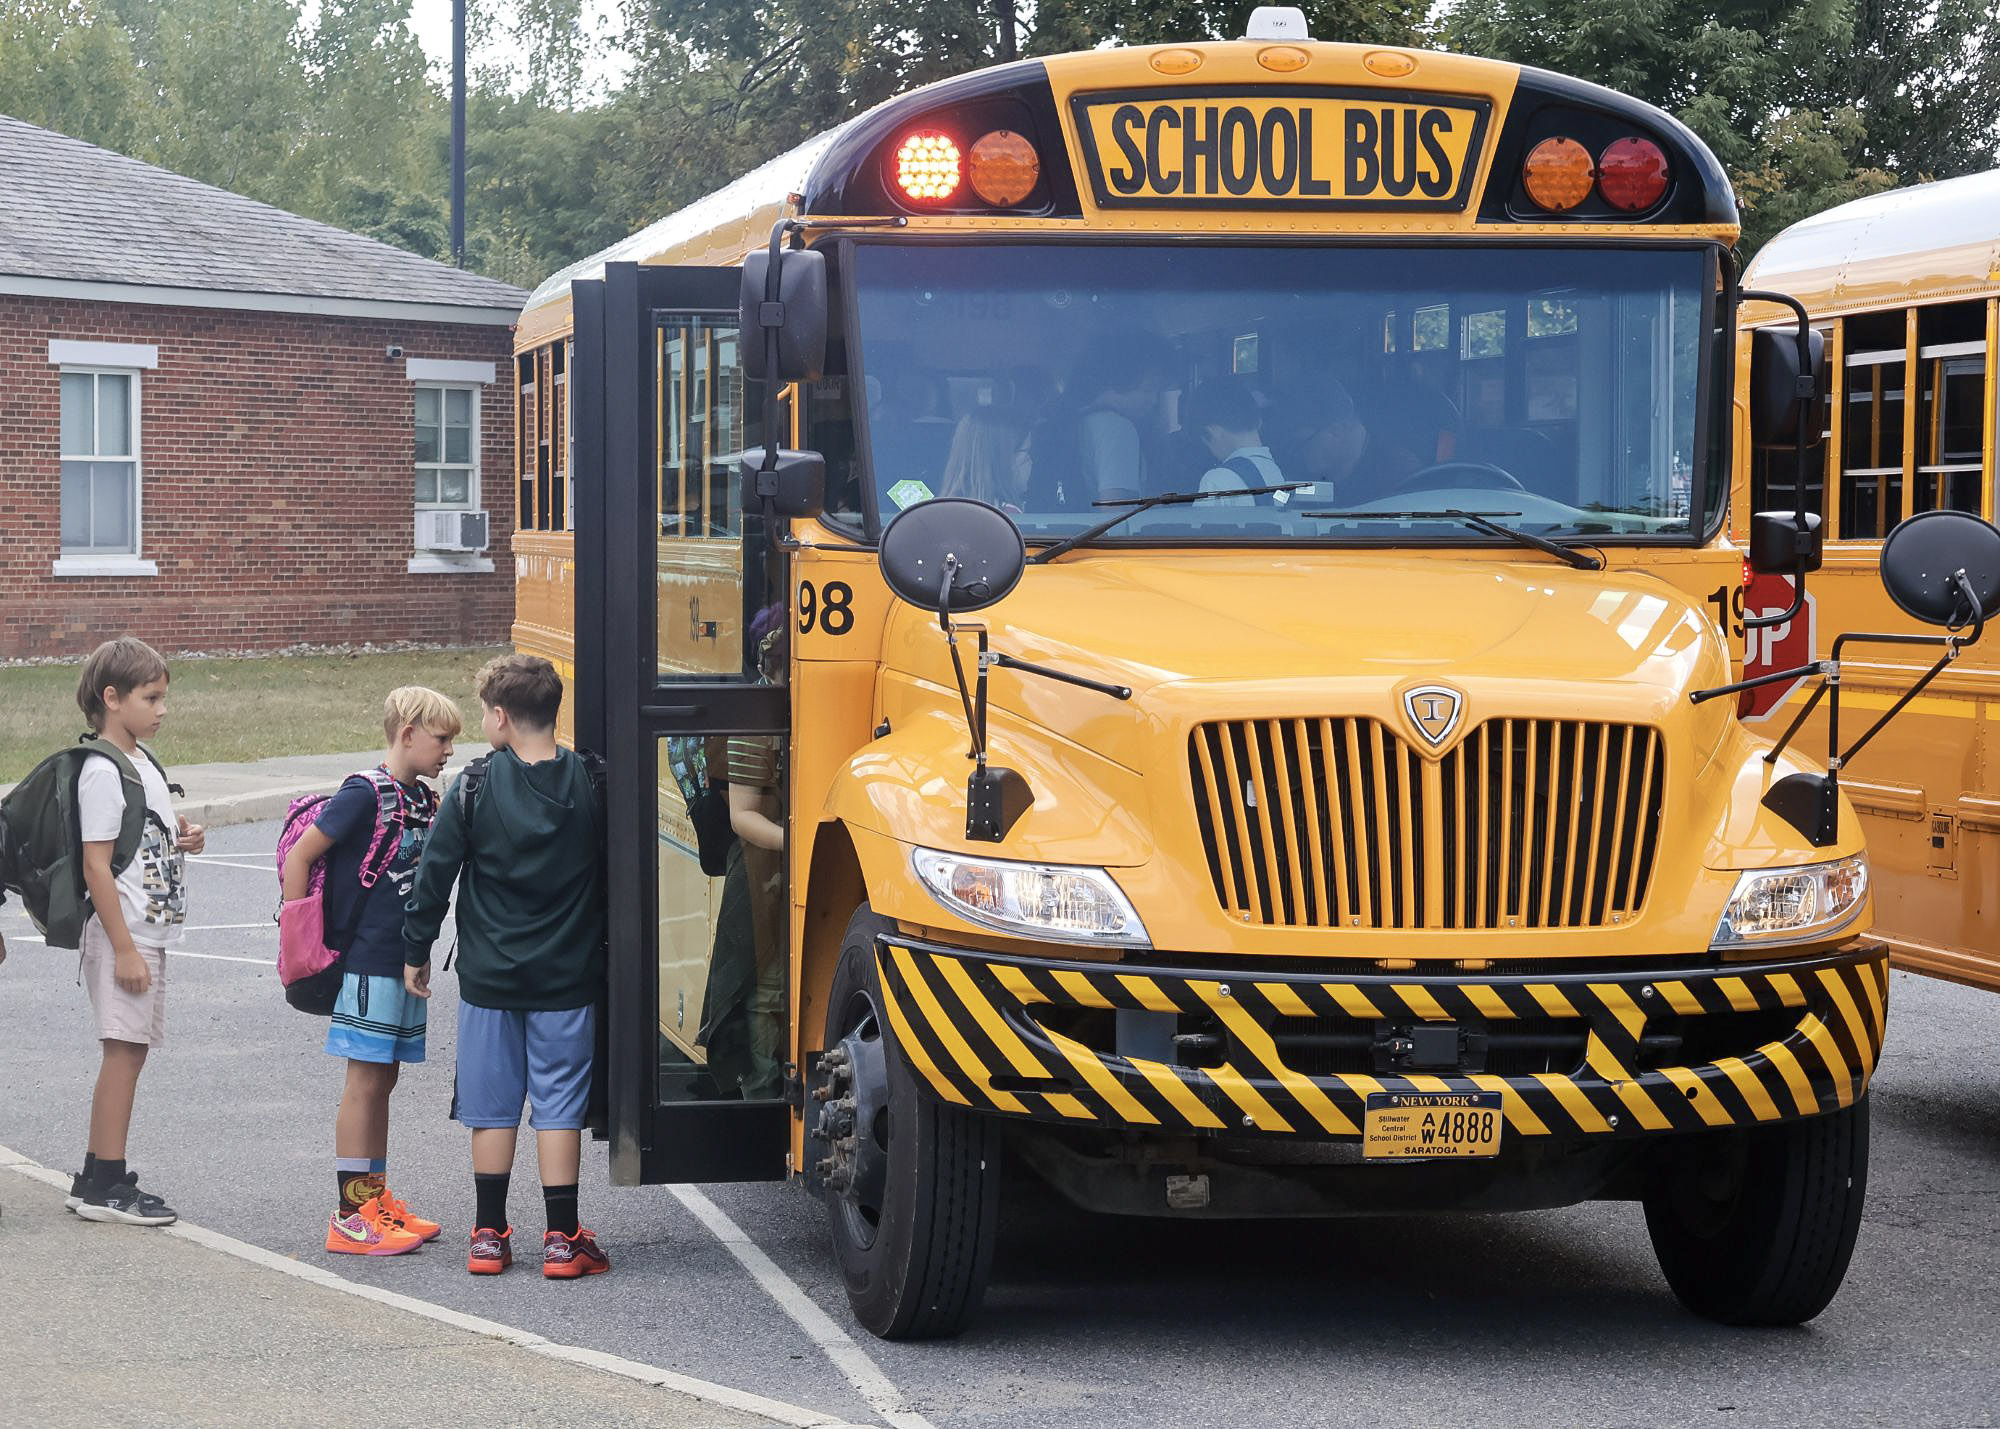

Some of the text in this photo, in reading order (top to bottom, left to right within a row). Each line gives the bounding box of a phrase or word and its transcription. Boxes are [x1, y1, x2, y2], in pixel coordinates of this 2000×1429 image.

[1109, 104, 1453, 198] SCHOOL BUS
[799, 580, 855, 635] 98
[1400, 1096, 1470, 1107] NEW YORK
[1378, 1115, 1410, 1123] Stillwater
[1438, 1111, 1494, 1144] 4888
[1369, 1134, 1417, 1142] School District
[1404, 1146, 1458, 1155] SARATOGA
